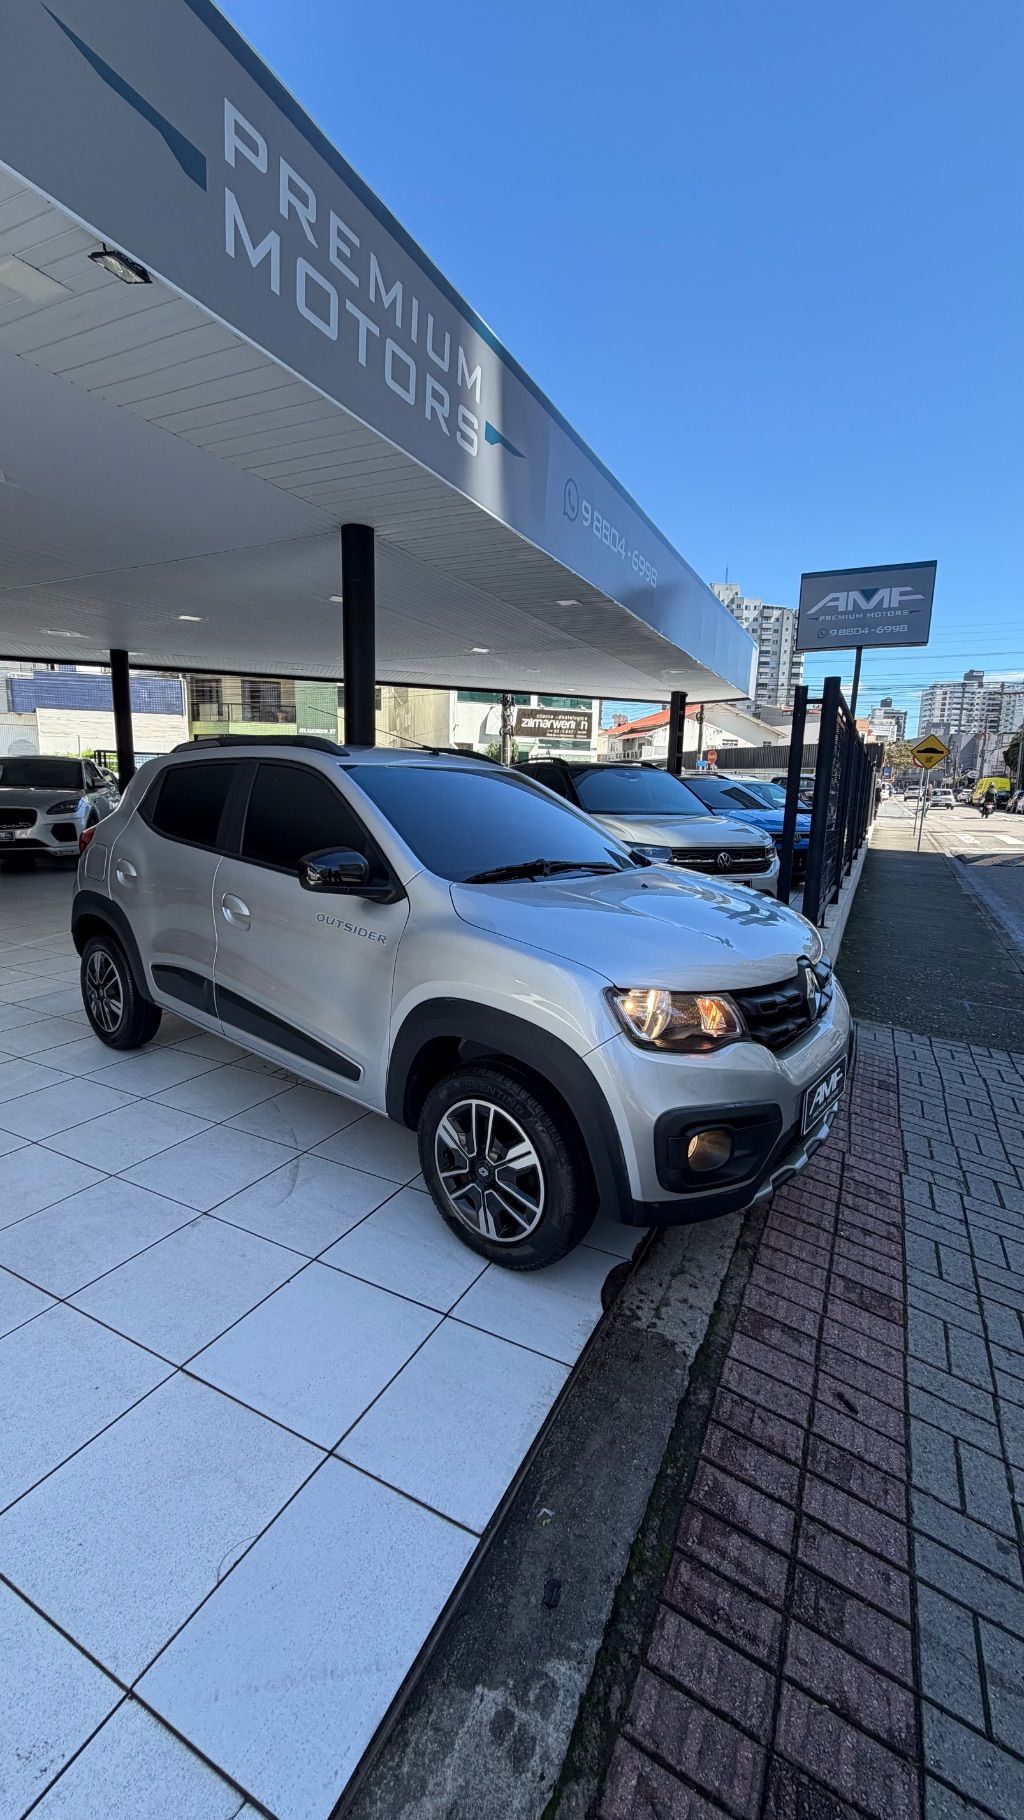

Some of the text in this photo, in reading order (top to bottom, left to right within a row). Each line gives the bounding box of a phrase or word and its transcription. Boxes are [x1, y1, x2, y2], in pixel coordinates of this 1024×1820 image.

[225, 97, 482, 404] PREMIUM
[225, 186, 479, 457] MOTORS
[806, 586, 926, 614] AMF
[819, 609, 909, 622] PREMIUM MOTORS
[316, 913, 387, 944] OUTSIDER
[808, 1067, 843, 1116] AMF
